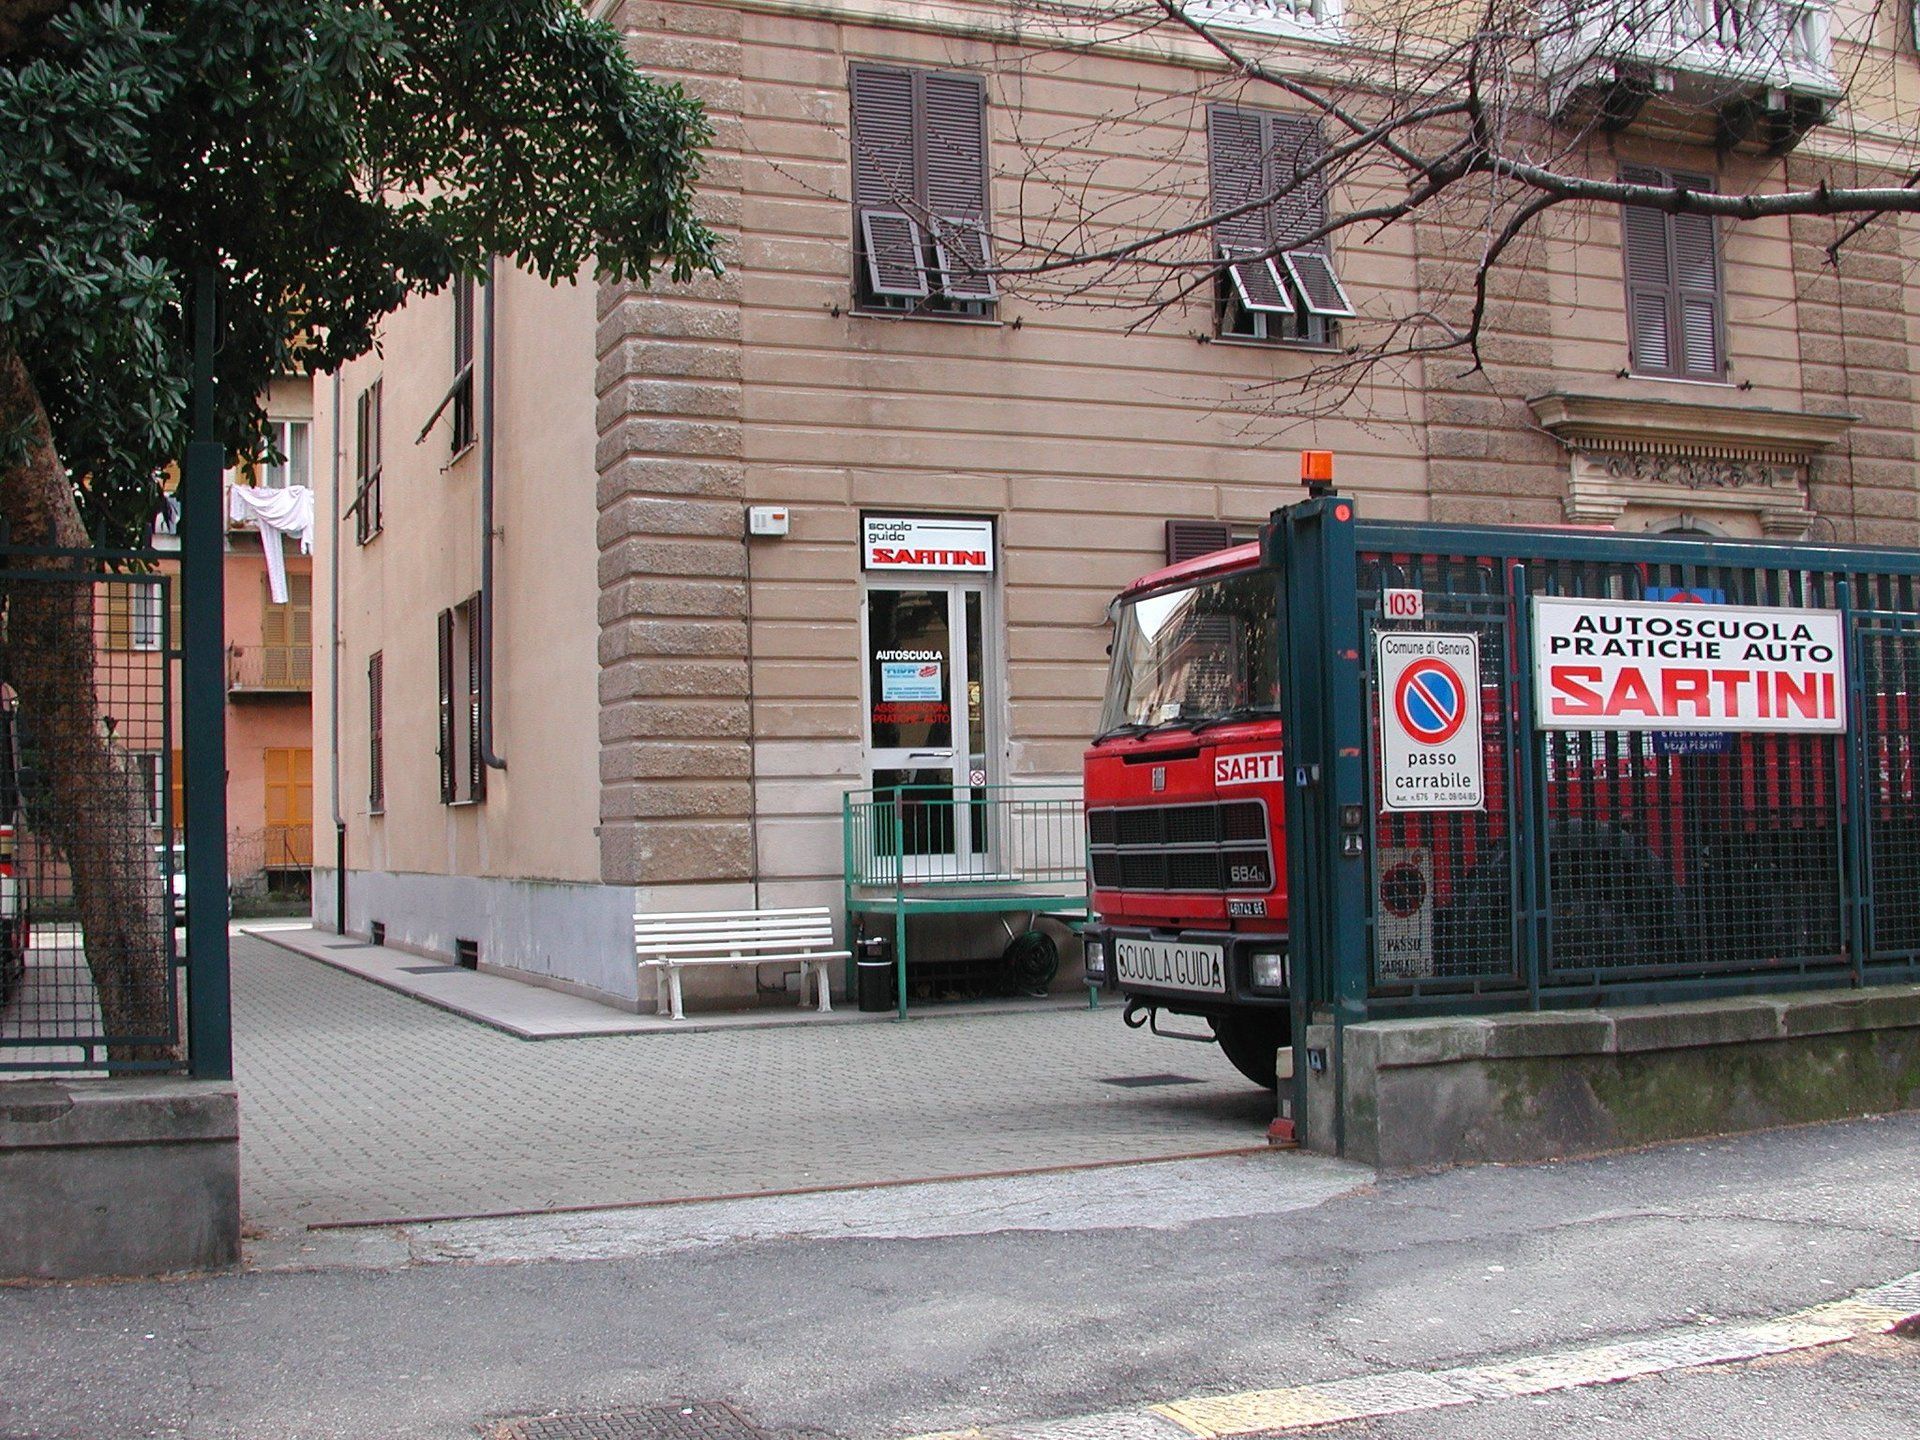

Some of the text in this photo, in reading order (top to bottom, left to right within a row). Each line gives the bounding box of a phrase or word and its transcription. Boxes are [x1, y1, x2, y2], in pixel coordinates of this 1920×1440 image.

[868, 521, 912, 532] scuola
[868, 531, 906, 544] guida
[872, 548, 986, 566] SARTINI
[1389, 592, 1418, 616] 103
[1573, 614, 1814, 642] AUTOSCUOLA
[875, 650, 943, 661] AUTOSCUOLA
[1386, 640, 1470, 656] Comune di Genova
[1550, 636, 1833, 664] PRATICHE AUTO
[1550, 665, 1837, 720] SARTINI
[1408, 752, 1457, 768] passo
[1395, 773, 1472, 790] carrabile
[1253, 902, 1264, 914] GE
[1118, 944, 1223, 988] SCUOLA GUIDA
